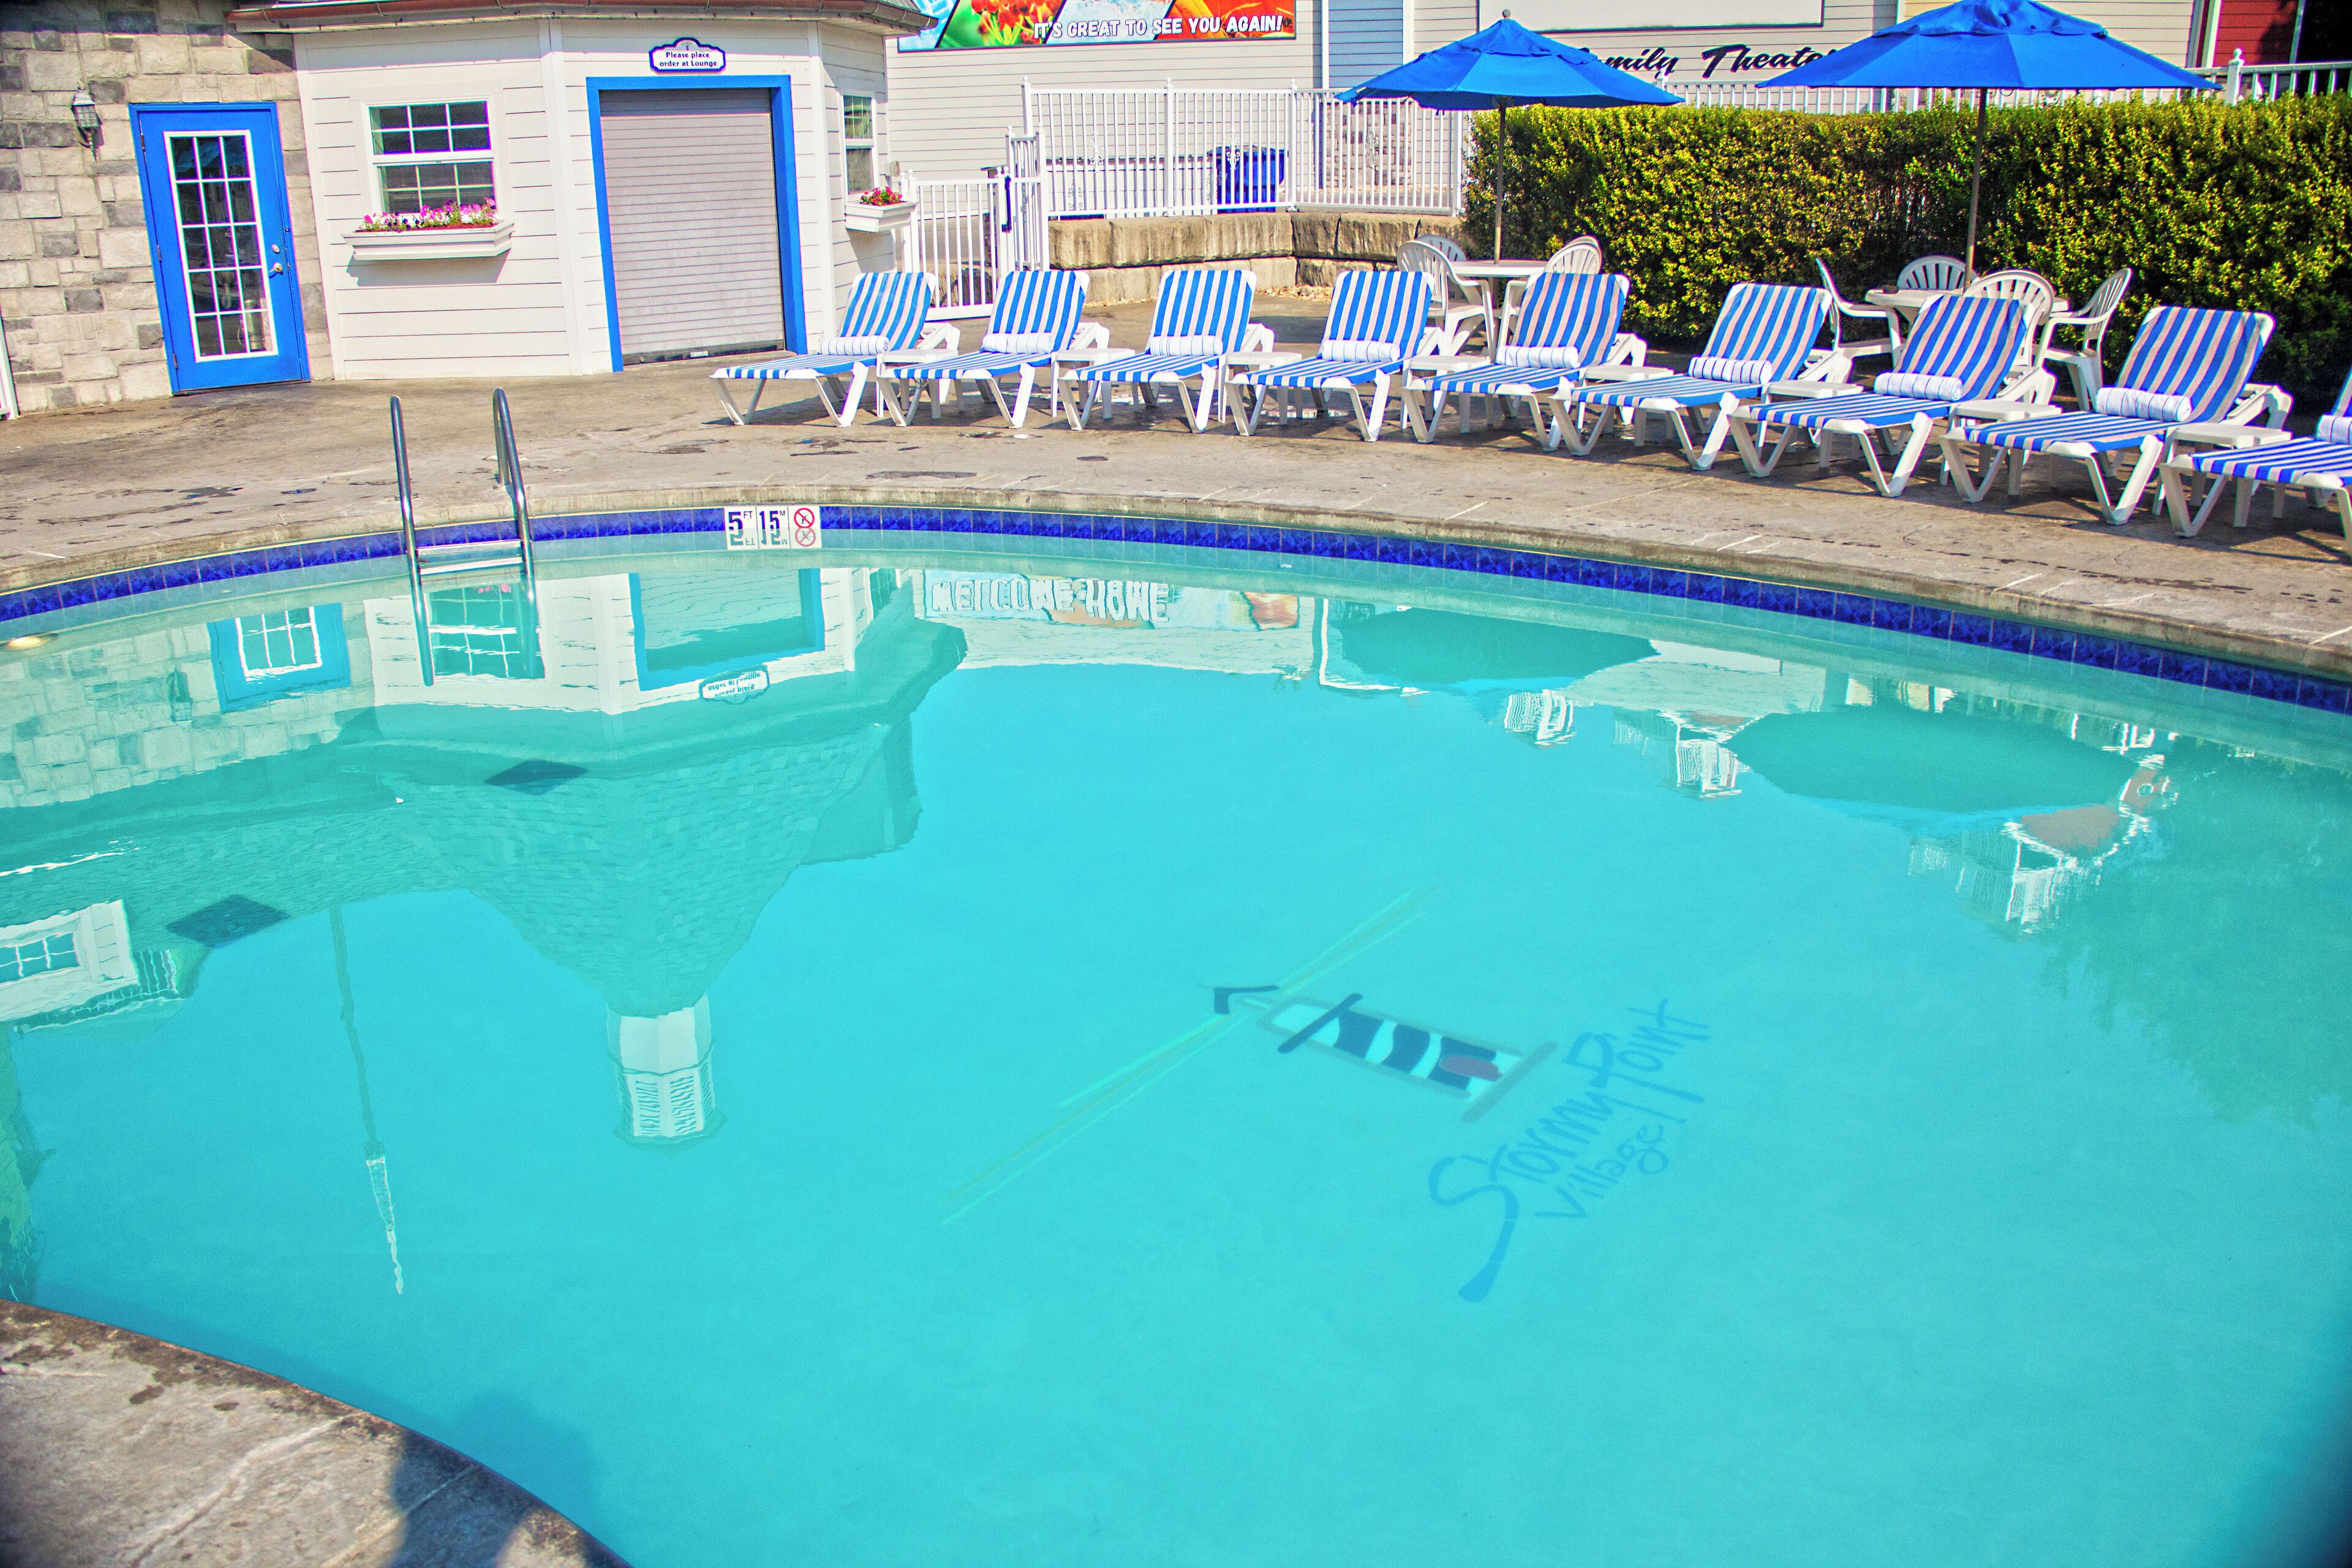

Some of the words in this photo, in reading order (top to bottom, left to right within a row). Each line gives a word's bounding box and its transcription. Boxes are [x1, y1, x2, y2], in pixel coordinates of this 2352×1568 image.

[1033, 20, 1063, 39] IT'S
[1067, 20, 1120, 37] GREAT
[1125, 18, 1147, 36] TO
[1152, 18, 1183, 34] SEE
[1188, 17, 1221, 33] YOU
[1226, 15, 1283, 32] AGAIN!
[743, 511, 753, 519] FT
[1428, 1091, 1686, 1303] Stormy
[1561, 998, 1711, 1104] Point
[1534, 1123, 1670, 1219] Village
